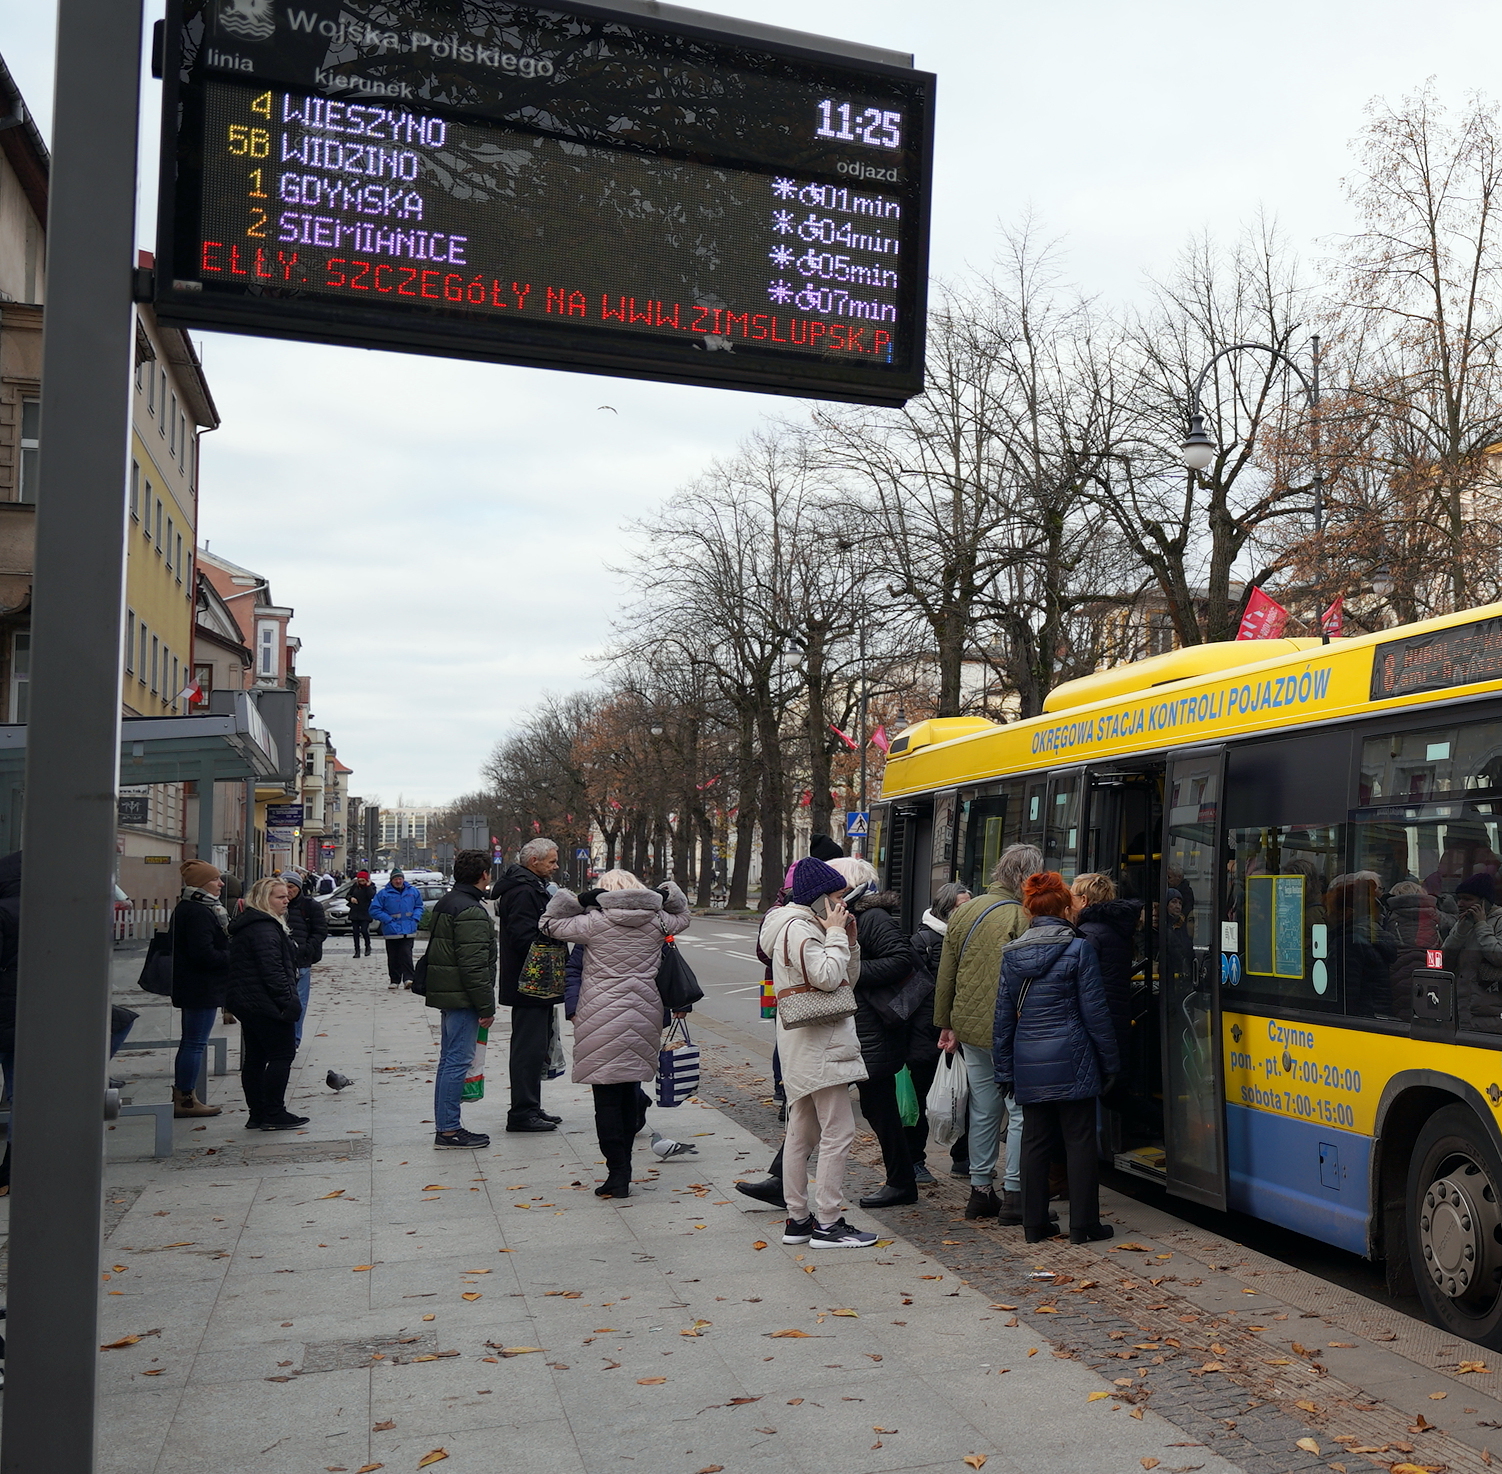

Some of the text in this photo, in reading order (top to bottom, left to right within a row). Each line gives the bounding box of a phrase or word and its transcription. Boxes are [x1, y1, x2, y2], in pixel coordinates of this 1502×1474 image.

[207, 48, 254, 73] linia
[287, 9, 554, 78] Wojska Polskiego
[315, 67, 413, 99] kierunek
[251, 89, 447, 148] 4 WIESZYNO
[816, 100, 901, 149] 11:25
[228, 123, 419, 182] 5B WIDZINO
[836, 159, 898, 183] odjazd
[248, 167, 424, 221] 1 GDYŃSKA
[246, 206, 468, 266] 2 SIEMIANICE
[326, 257, 532, 311] SZCZEGÓŁY
[545, 286, 587, 319] NA
[1384, 654, 1396, 692] 8
[1031, 664, 1332, 756] OKRĘGOWA STACJA KONTROLI POJAZDÓW
[1267, 1019, 1315, 1050] Czynne
[1230, 1050, 1256, 1071] pon.
[1265, 1058, 1282, 1079] pt.
[1291, 1062, 1362, 1094] 7:00-20:00
[1240, 1084, 1354, 1127] sobota 7:00-15:00
